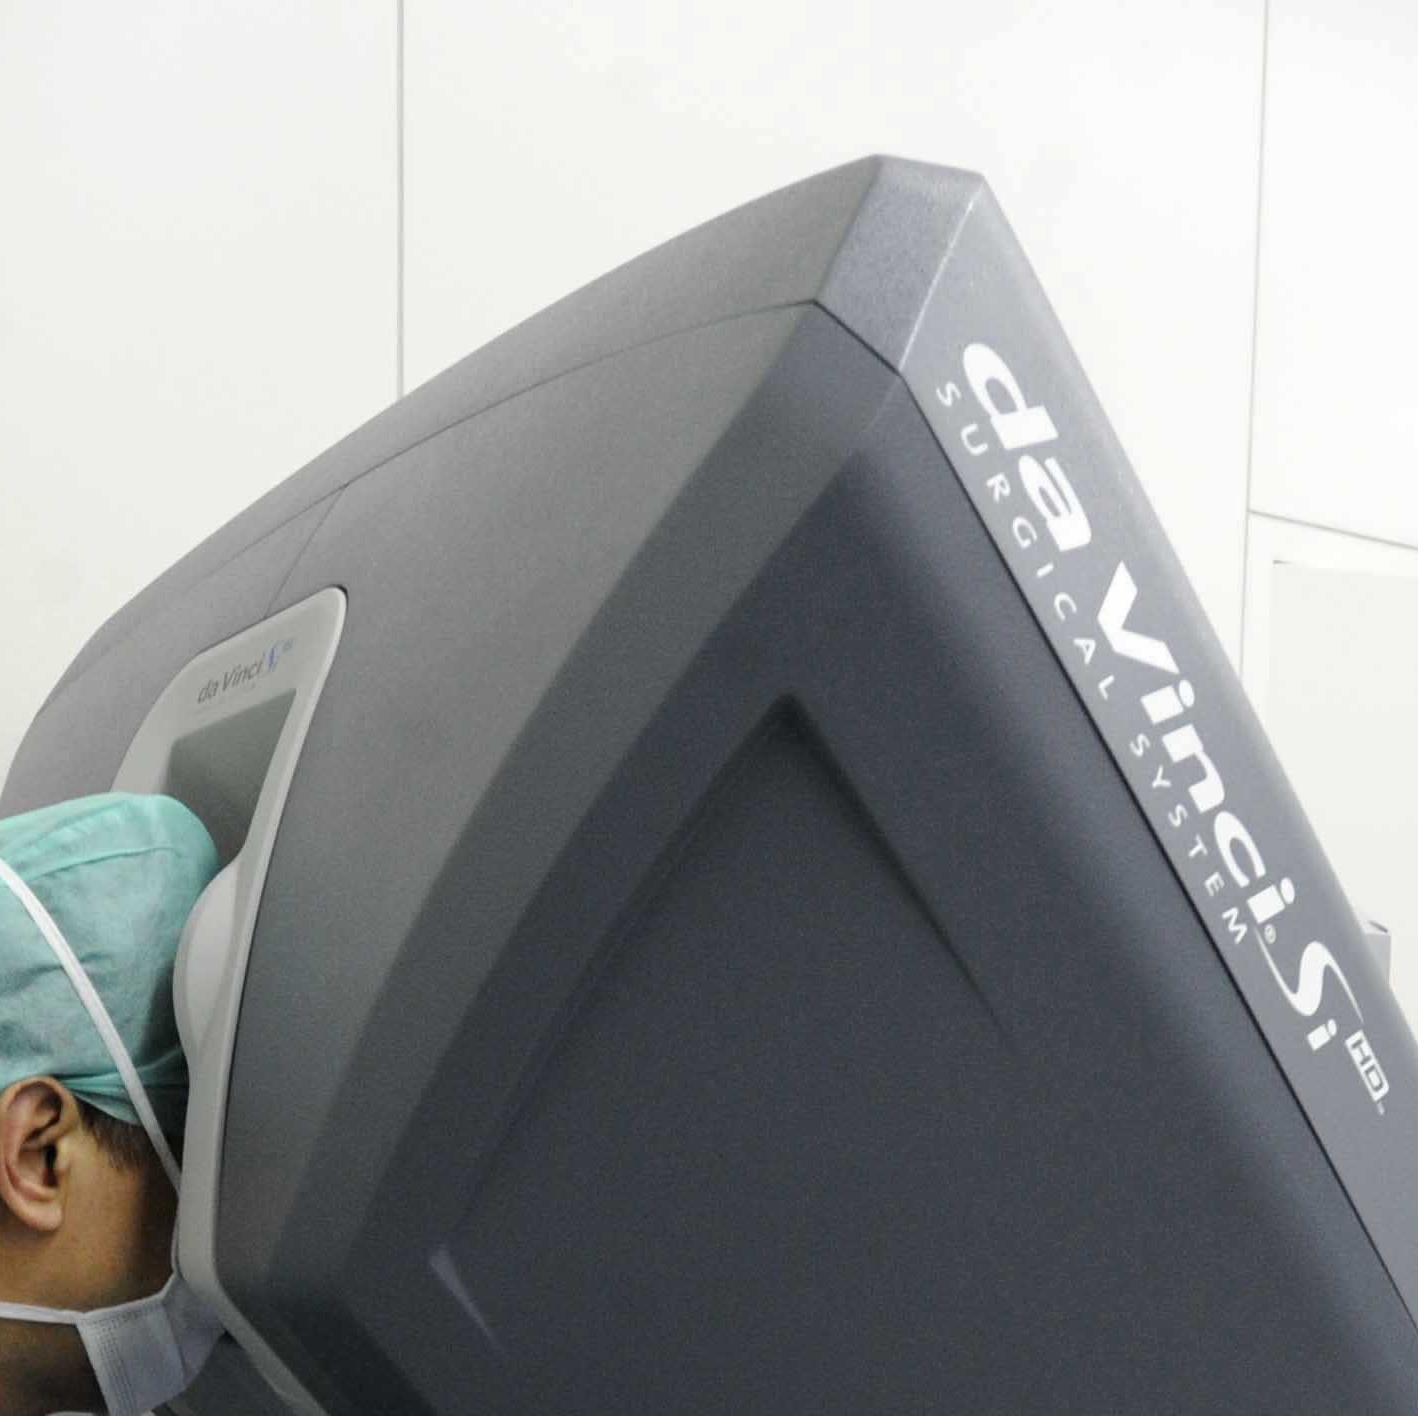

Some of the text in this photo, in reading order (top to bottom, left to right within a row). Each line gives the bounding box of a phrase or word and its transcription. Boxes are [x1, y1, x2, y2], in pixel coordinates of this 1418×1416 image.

[963, 343, 1092, 552] da
[936, 382, 1248, 944] SURGICAL SYSTEM
